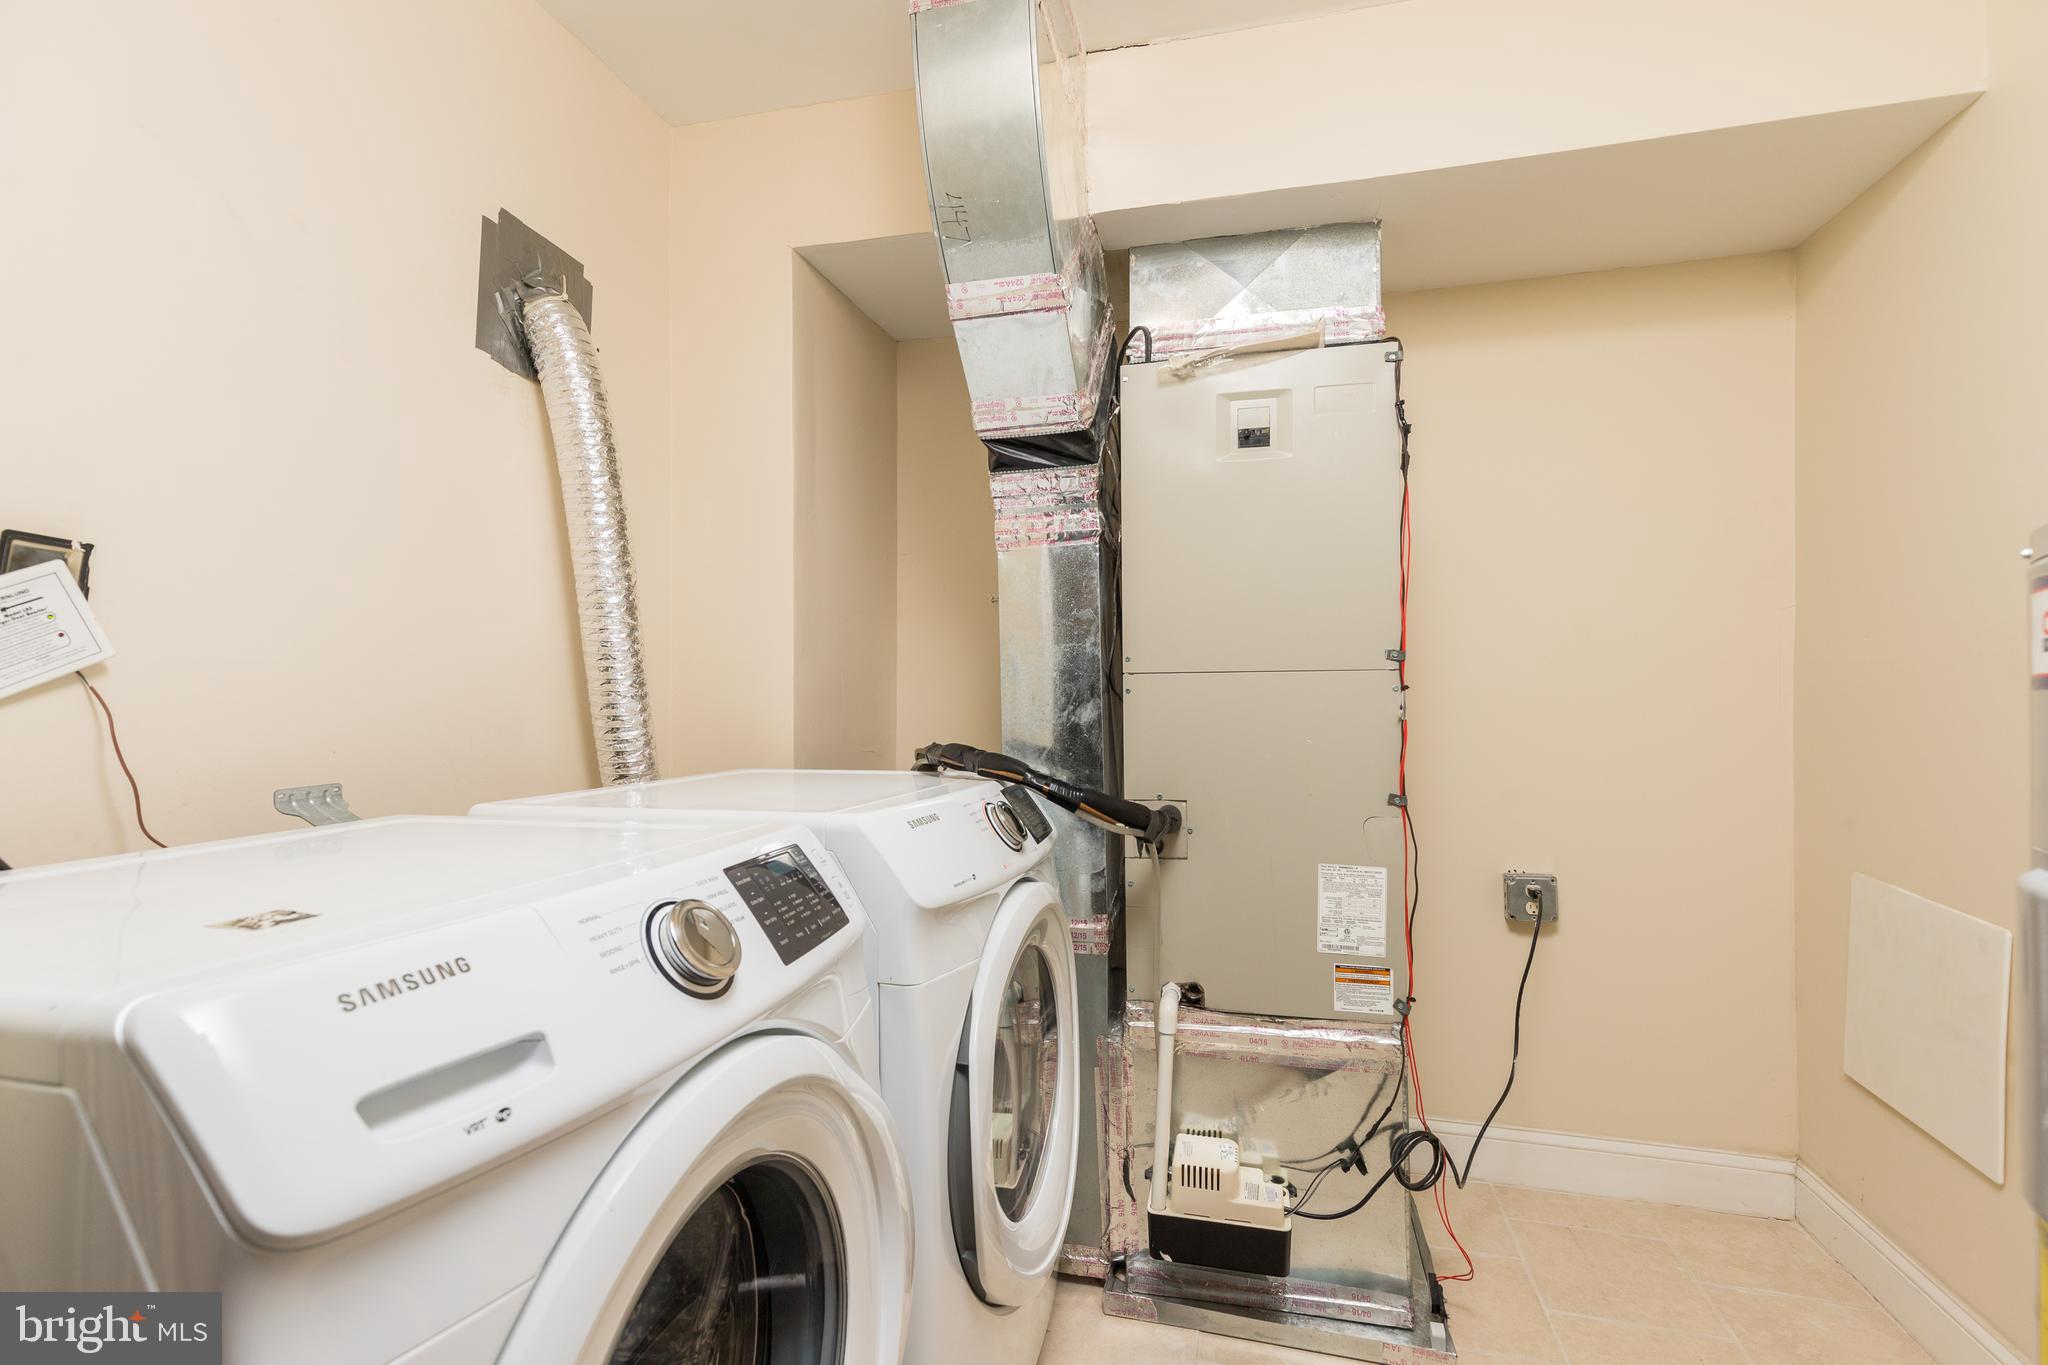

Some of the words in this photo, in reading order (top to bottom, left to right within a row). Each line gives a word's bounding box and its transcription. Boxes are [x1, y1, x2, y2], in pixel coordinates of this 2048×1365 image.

[907, 813, 941, 830] SAMSUNG
[336, 956, 472, 1013] SAMSUNG
[1351, 1307, 1372, 1319] 04/16
